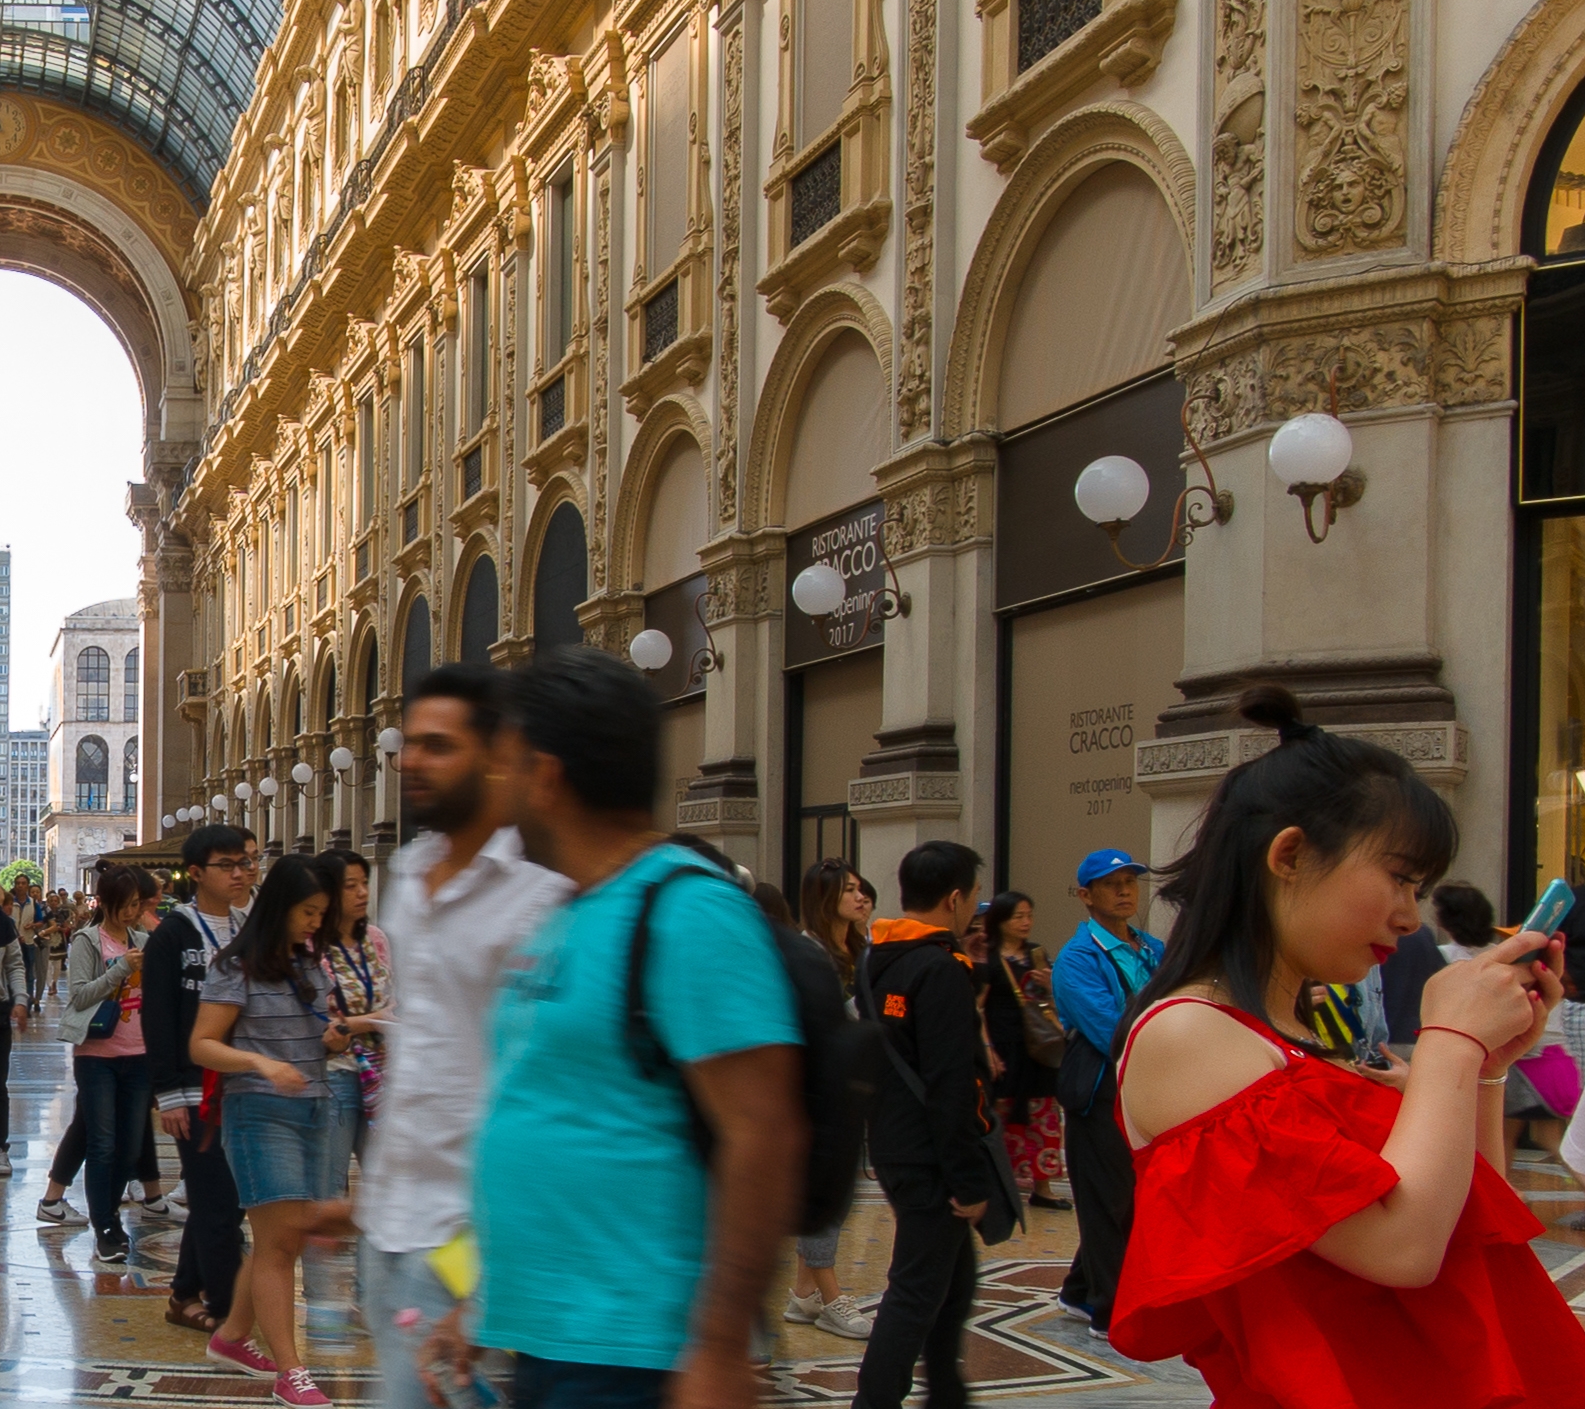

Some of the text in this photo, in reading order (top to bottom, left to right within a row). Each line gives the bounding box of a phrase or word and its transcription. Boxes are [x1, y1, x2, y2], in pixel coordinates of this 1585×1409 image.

[812, 513, 877, 558] RISTORANTE
[829, 623, 855, 646] 2017
[1070, 704, 1134, 728] RISTORANTE
[1069, 724, 1134, 754] CRACCO
[1070, 773, 1132, 796] next opening
[1086, 798, 1112, 815] 2017
